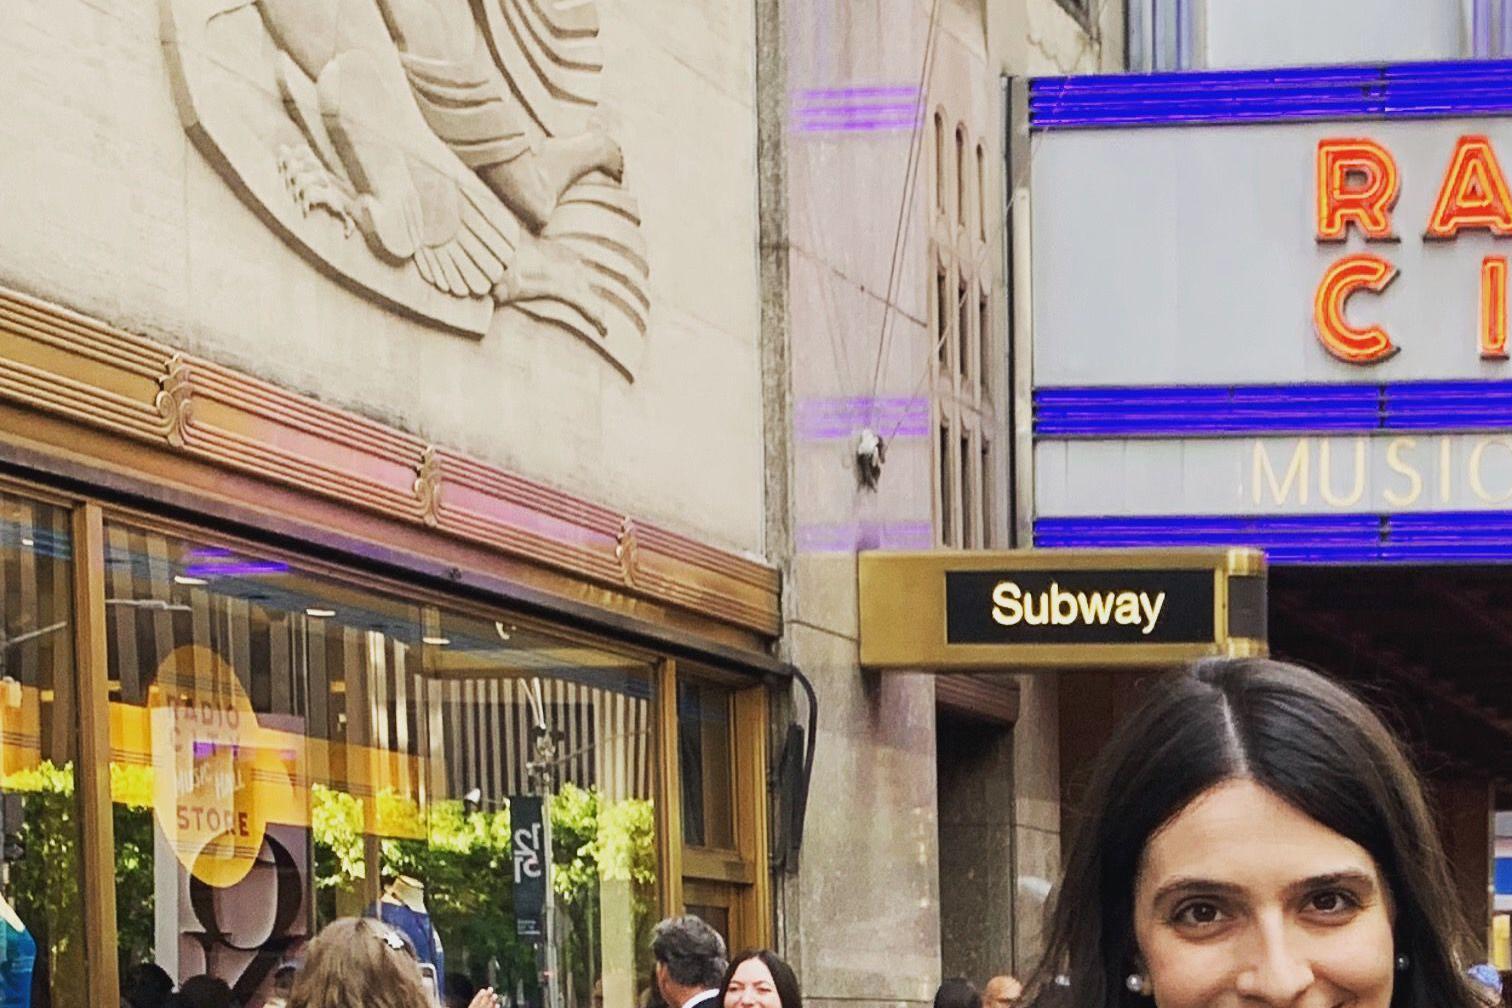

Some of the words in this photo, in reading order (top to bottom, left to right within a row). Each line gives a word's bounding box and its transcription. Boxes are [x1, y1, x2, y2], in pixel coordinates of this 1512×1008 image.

[991, 580, 1166, 635] Subway
[165, 692, 240, 730] RADIO
[176, 803, 250, 837] STORE
